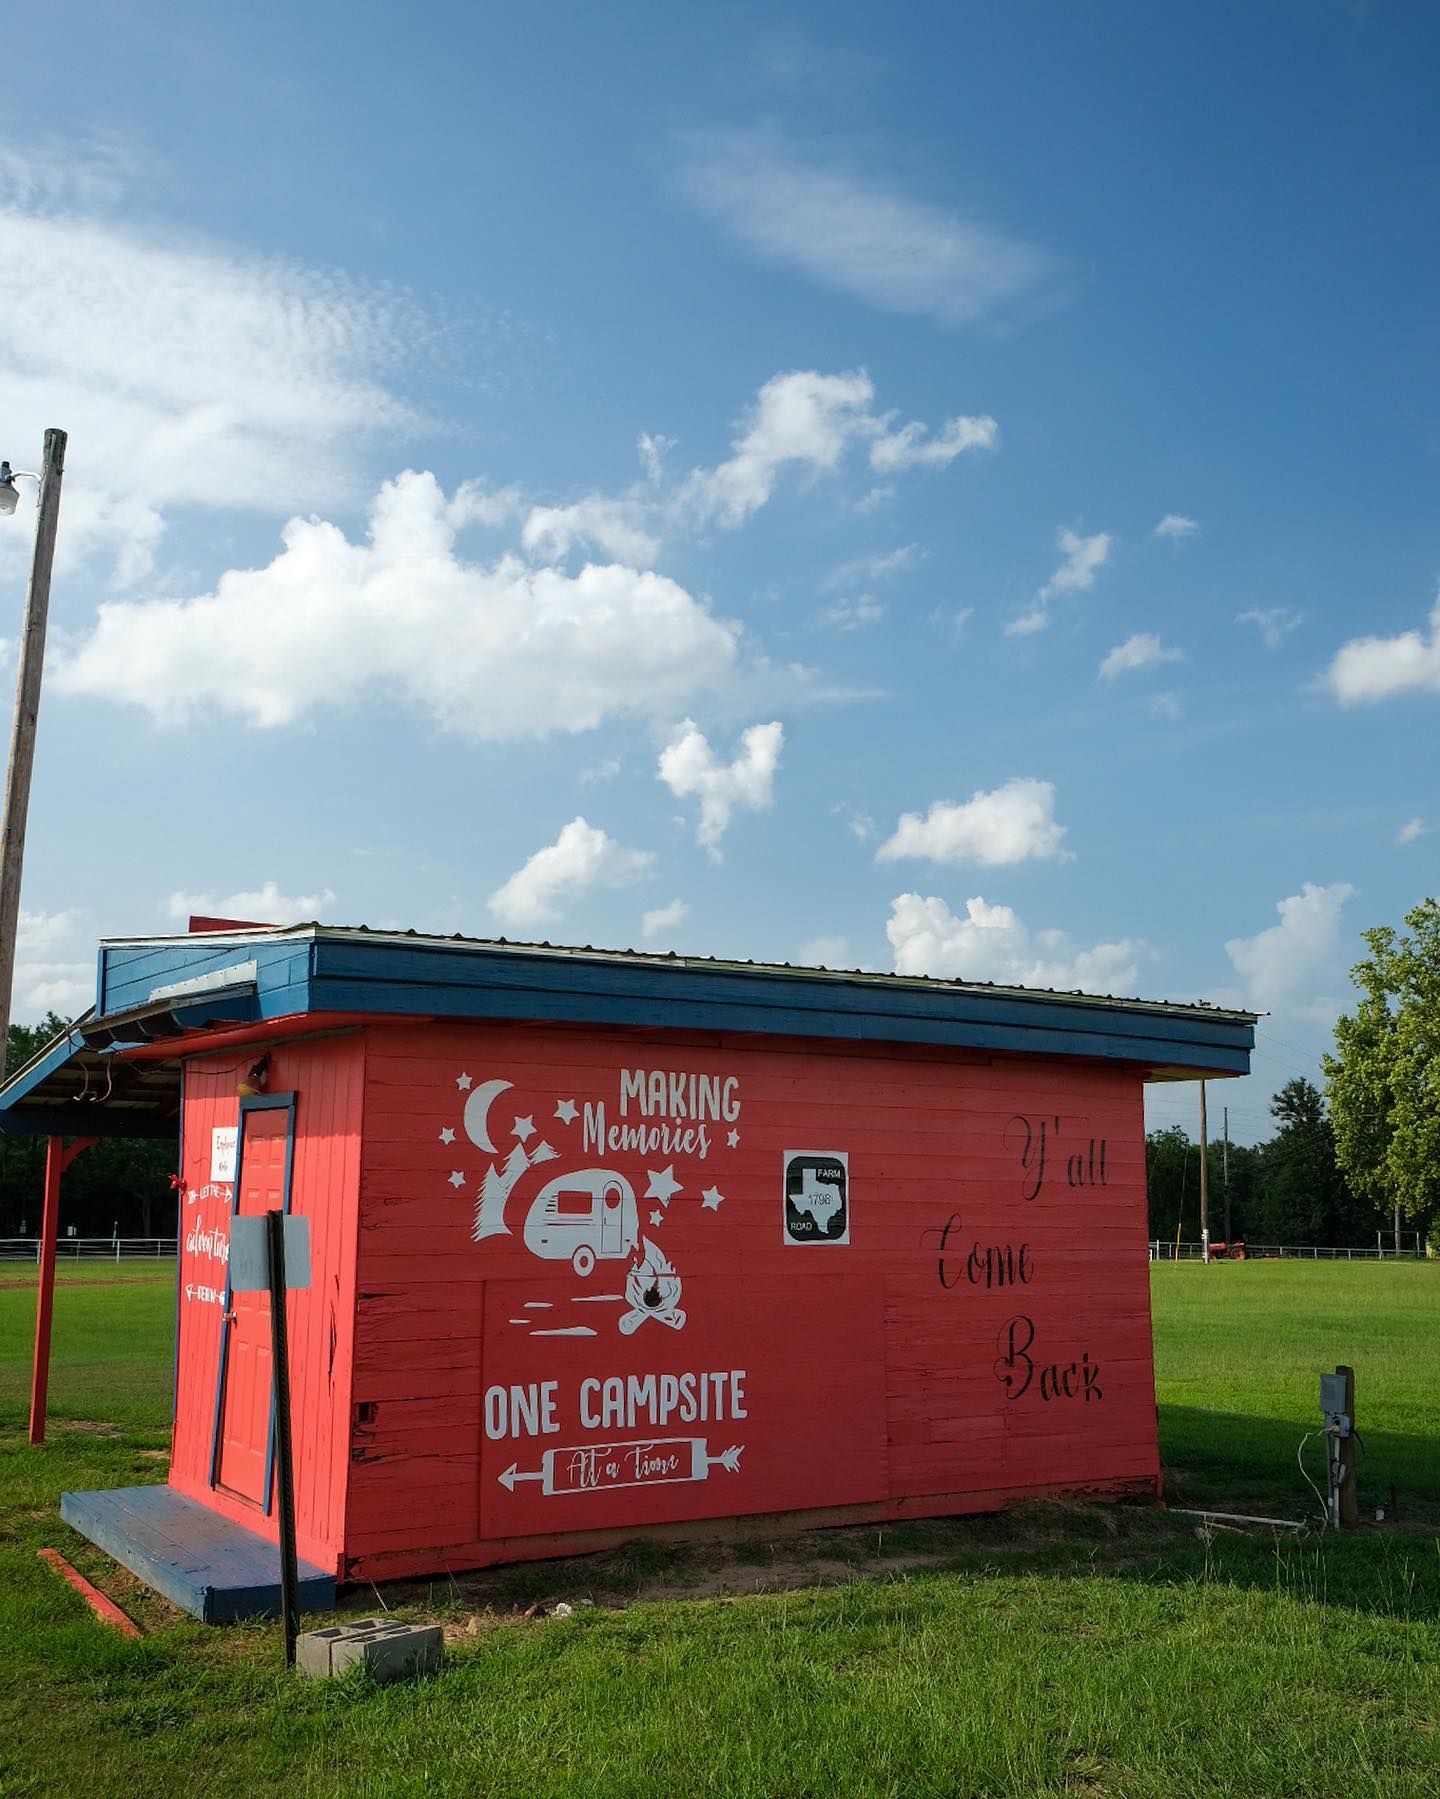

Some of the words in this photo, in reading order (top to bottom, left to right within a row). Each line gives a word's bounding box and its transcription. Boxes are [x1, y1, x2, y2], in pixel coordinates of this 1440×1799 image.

[620, 1068, 741, 1122] MAKING
[583, 1100, 712, 1160] Memories
[817, 1168, 841, 1179] FARM
[790, 1221, 813, 1232] ROAD
[920, 1212, 1034, 1289] Come
[993, 1315, 1103, 1401] Back
[484, 1380, 561, 1440] ONE
[579, 1369, 748, 1429] CAMPSITE
[566, 1447, 612, 1488] At
